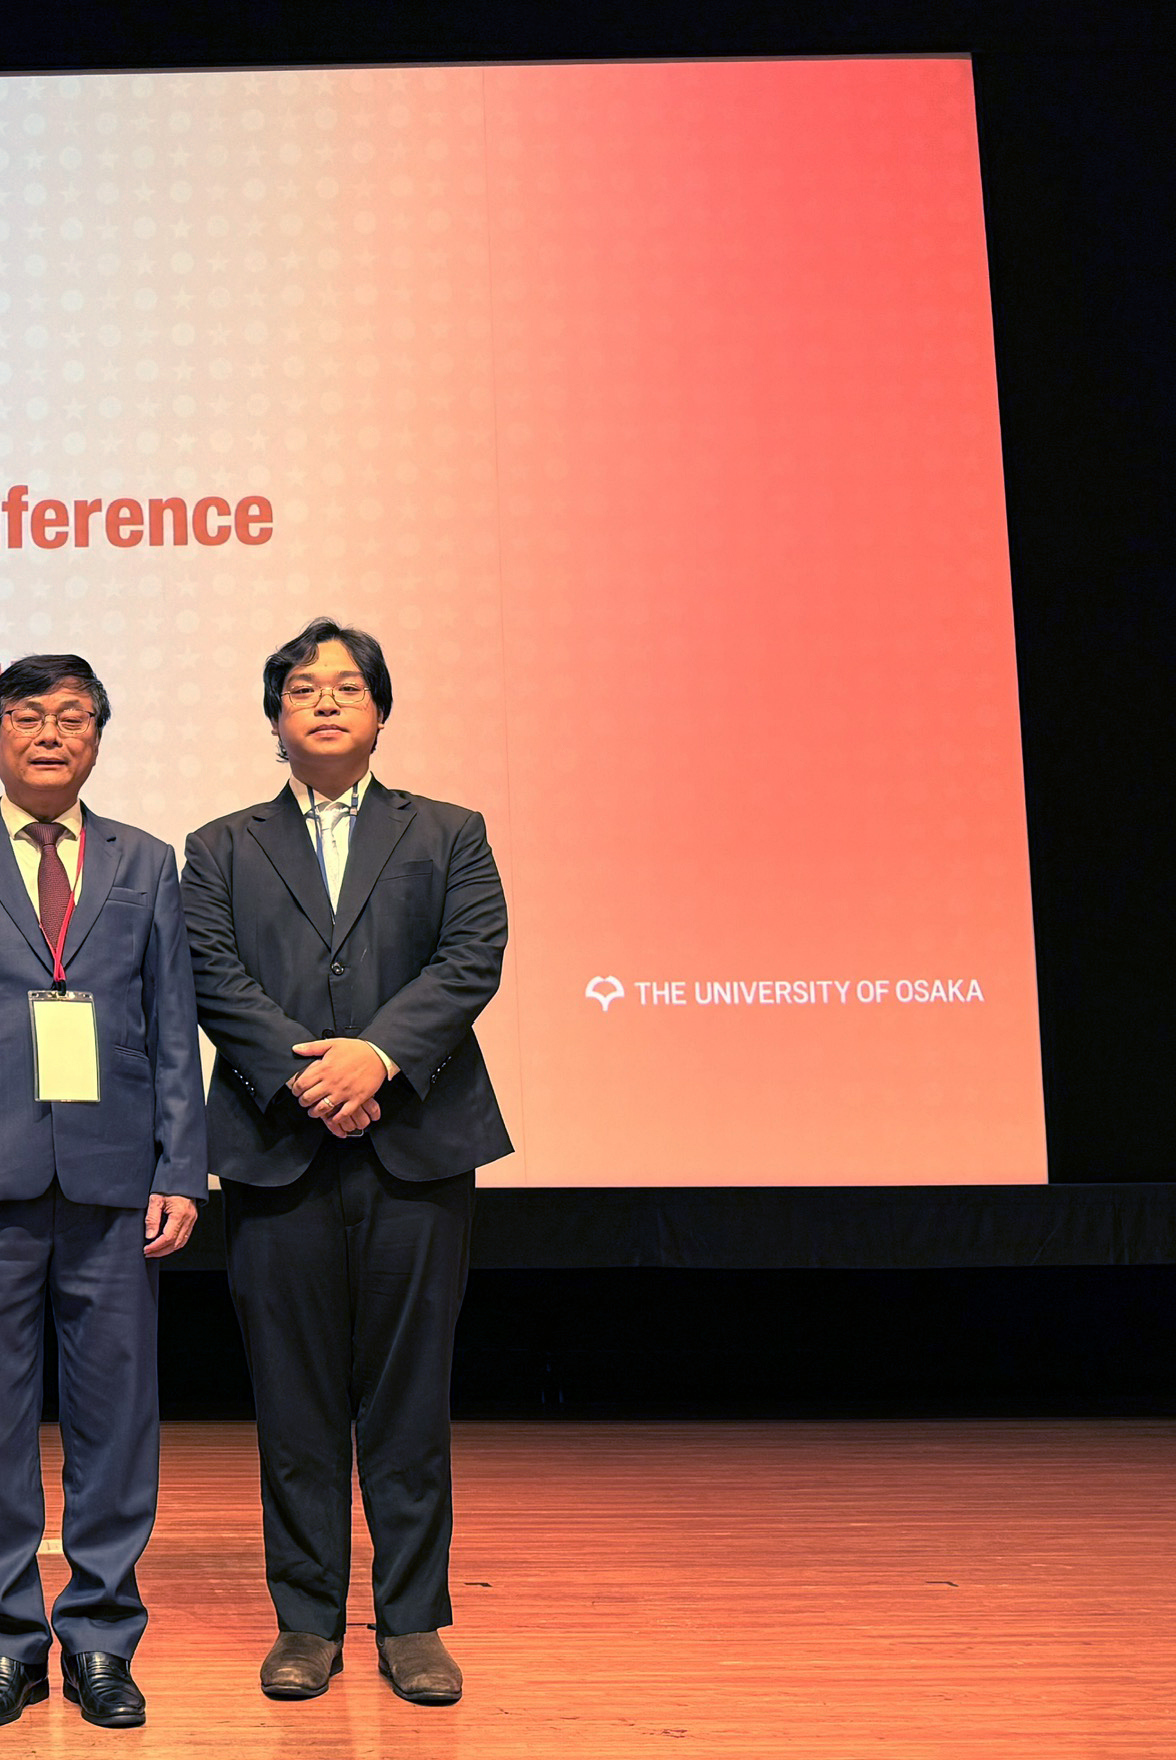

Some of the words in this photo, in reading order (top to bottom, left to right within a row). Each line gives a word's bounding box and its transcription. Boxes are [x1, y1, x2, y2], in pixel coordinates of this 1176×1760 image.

[634, 981, 686, 1006] THE
[694, 979, 851, 1006] UNIVERSITY
[856, 979, 890, 1004] OF
[895, 978, 985, 1004] OSAKA
